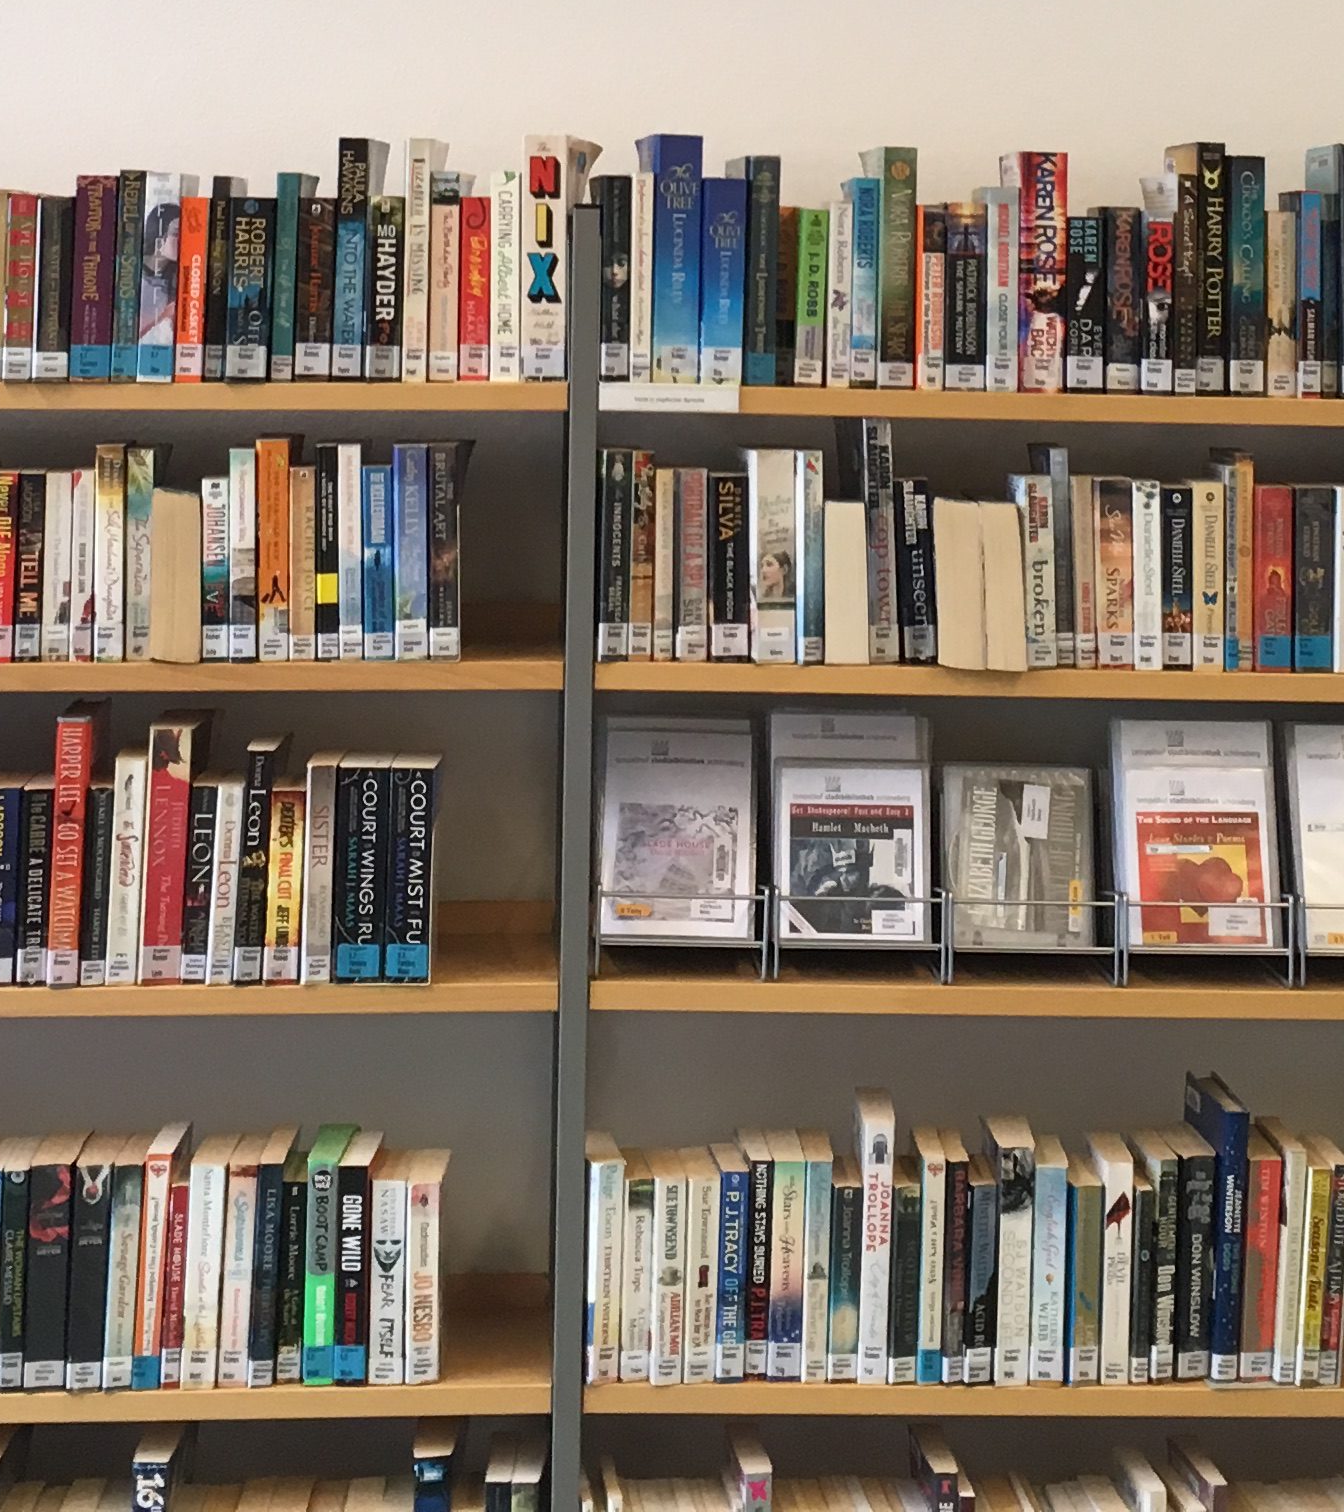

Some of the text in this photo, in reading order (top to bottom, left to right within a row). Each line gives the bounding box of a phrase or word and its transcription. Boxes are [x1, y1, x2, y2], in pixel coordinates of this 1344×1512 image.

[341, 150, 354, 214] HAWKINS
[353, 162, 365, 202] PAULA
[1033, 153, 1056, 286] KAREN ROSE
[234, 217, 249, 288] HARRIS
[251, 217, 266, 287] ROBERT
[497, 190, 514, 335] CARRYING Albert HOME
[527, 156, 562, 305] NIX
[857, 187, 874, 268] NORA ROBERTS
[188, 254, 202, 343] CLOSED CASKET
[375, 225, 396, 320] MO HAYDER
[965, 259, 977, 355] PATRICK ROBINSON
[1205, 197, 1224, 338] HARRY POTTER
[718, 482, 733, 541] SILVA
[1032, 560, 1049, 637] broken
[1106, 568, 1121, 629] SPARKS
[59, 727, 83, 803] HARPER LEE
[247, 788, 266, 846] Leon
[311, 805, 329, 869] SISTER
[358, 779, 378, 915] COURT WINGS
[407, 780, 427, 909] COURT MIST
[811, 822, 890, 835] Hamlet Macbeth
[262, 1188, 275, 1271] LISA MOORE
[315, 1195, 329, 1271] BOOT CAMP
[342, 1194, 362, 1271] GONE WILD
[751, 1164, 768, 1283] NOTHING STAYS BURIED
[866, 1172, 879, 1253] TROLLOPE
[879, 1181, 890, 1246] JOANNA
[1190, 1233, 1202, 1337] DON WINSLOW
